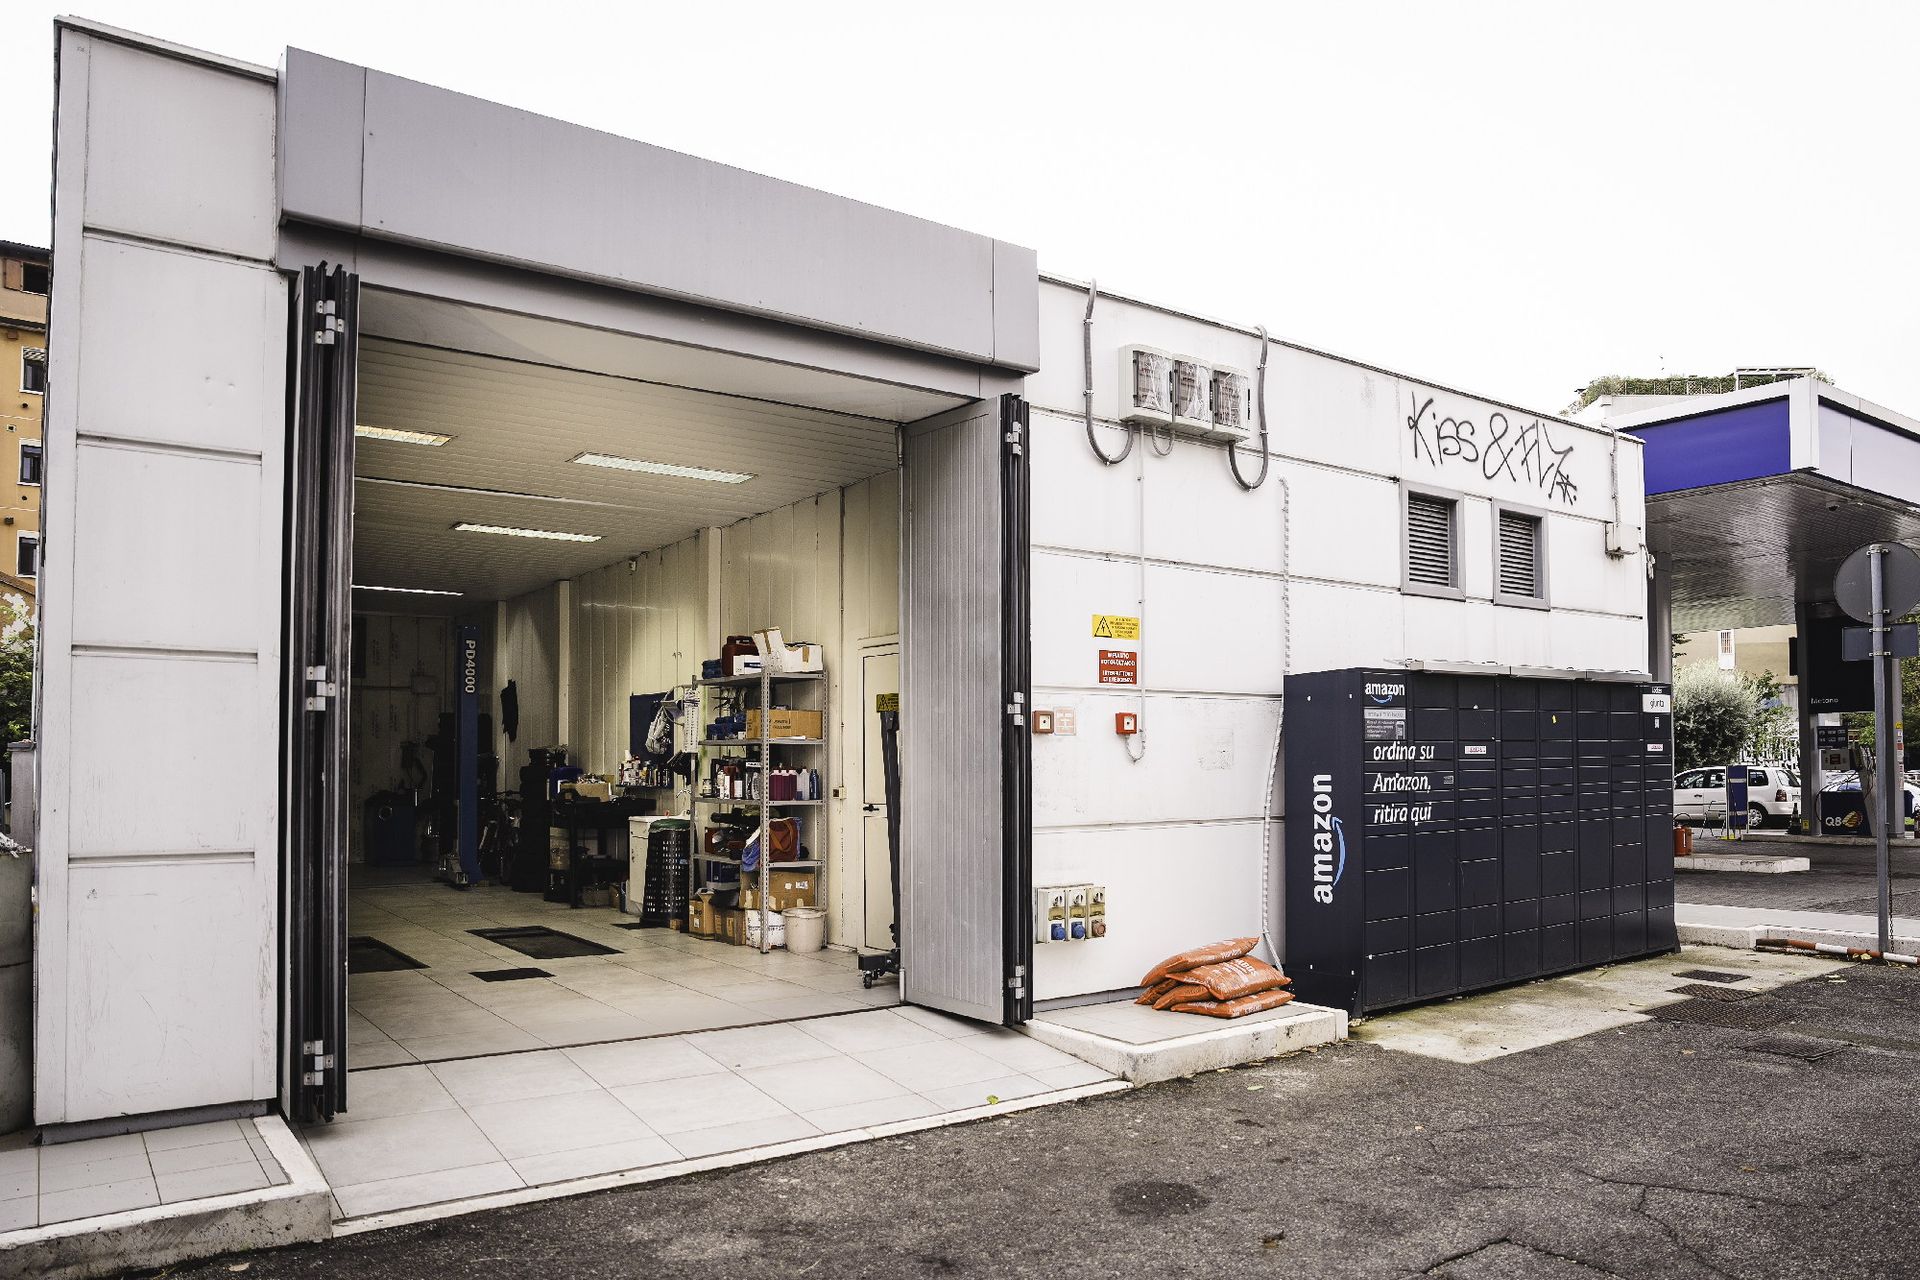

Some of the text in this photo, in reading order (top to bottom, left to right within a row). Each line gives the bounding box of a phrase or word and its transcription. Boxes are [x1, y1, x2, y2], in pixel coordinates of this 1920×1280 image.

[1483, 412, 1517, 482] &
[465, 639, 476, 694] PD4000
[1364, 682, 1406, 696] amazon
[1373, 741, 1435, 760] ordina su
[1373, 773, 1431, 793] Amazon,
[1373, 802, 1432, 826] ritira qui
[1825, 816, 1842, 827] Q8
[1312, 774, 1334, 904] amazon
